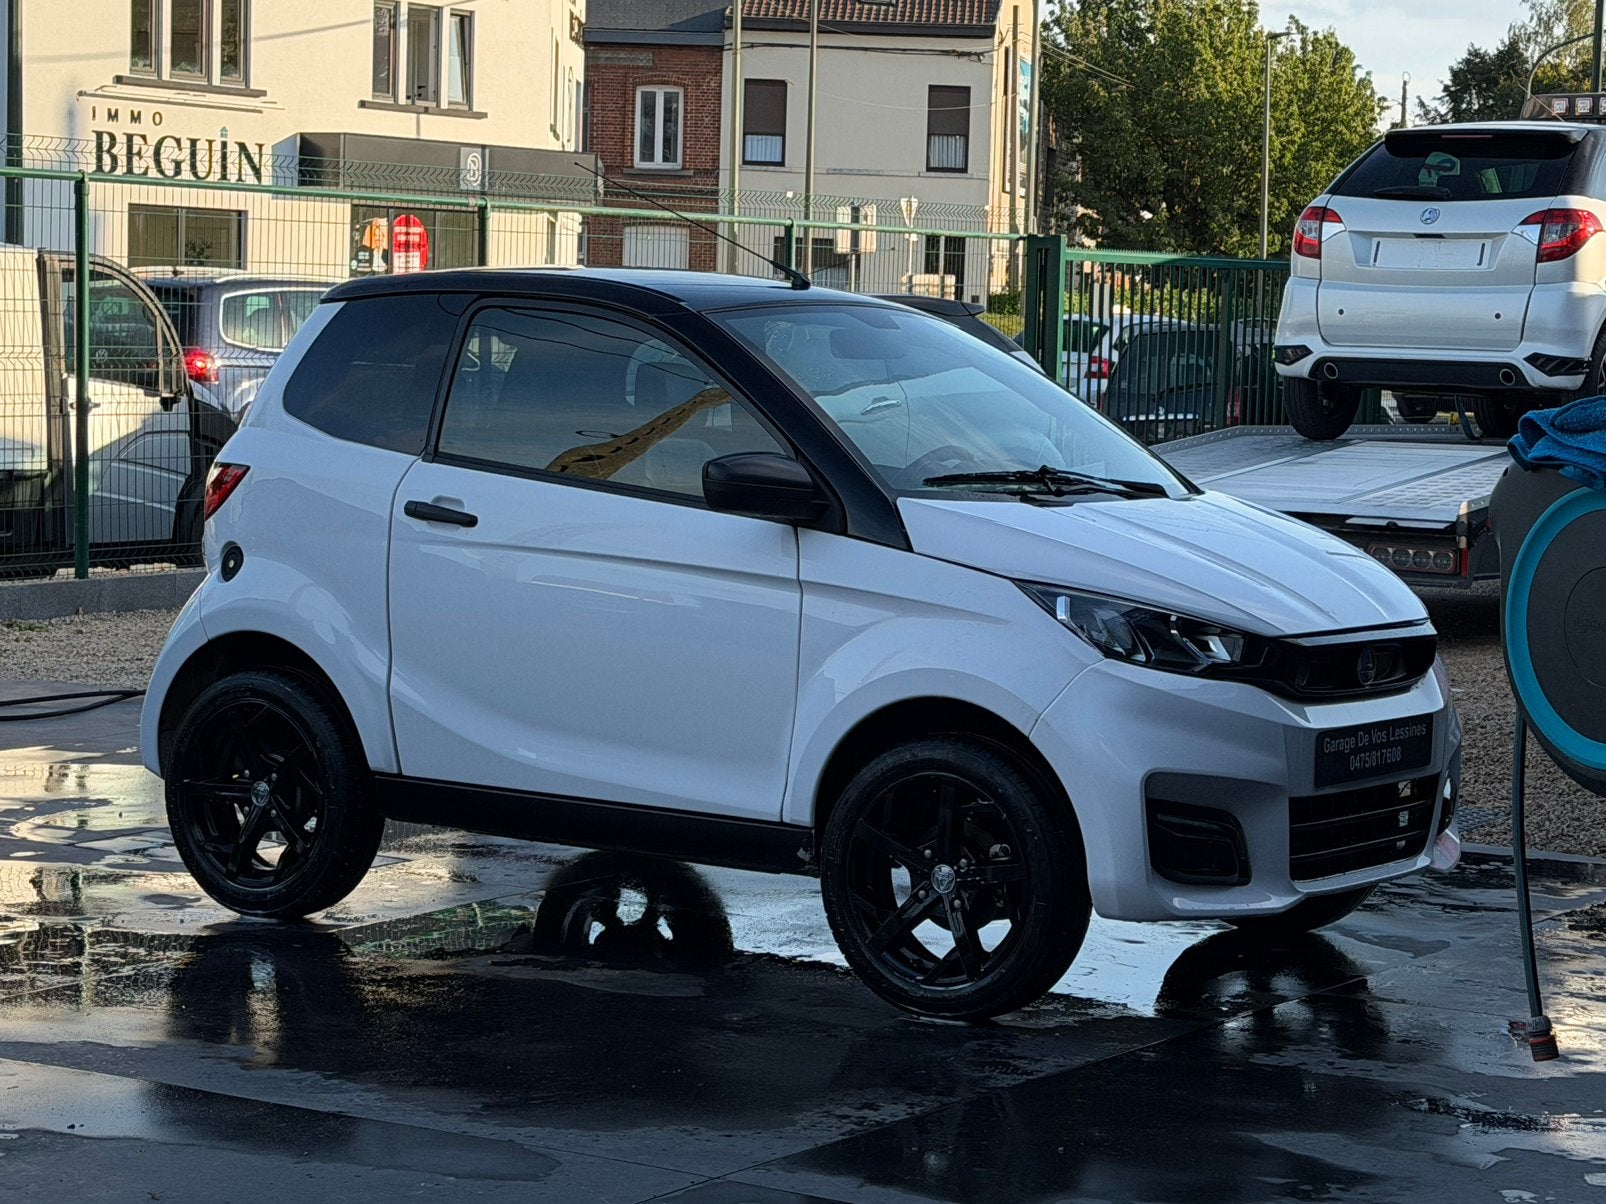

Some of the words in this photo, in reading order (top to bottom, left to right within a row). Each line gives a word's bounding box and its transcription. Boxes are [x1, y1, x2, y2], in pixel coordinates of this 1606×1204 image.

[91, 105, 163, 126] IMMO
[1323, 736, 1356, 753] Garage
[1357, 731, 1369, 747] De
[1371, 728, 1387, 744] Vos
[1389, 722, 1427, 742] Lessines
[1349, 746, 1402, 771] 0475/817608
